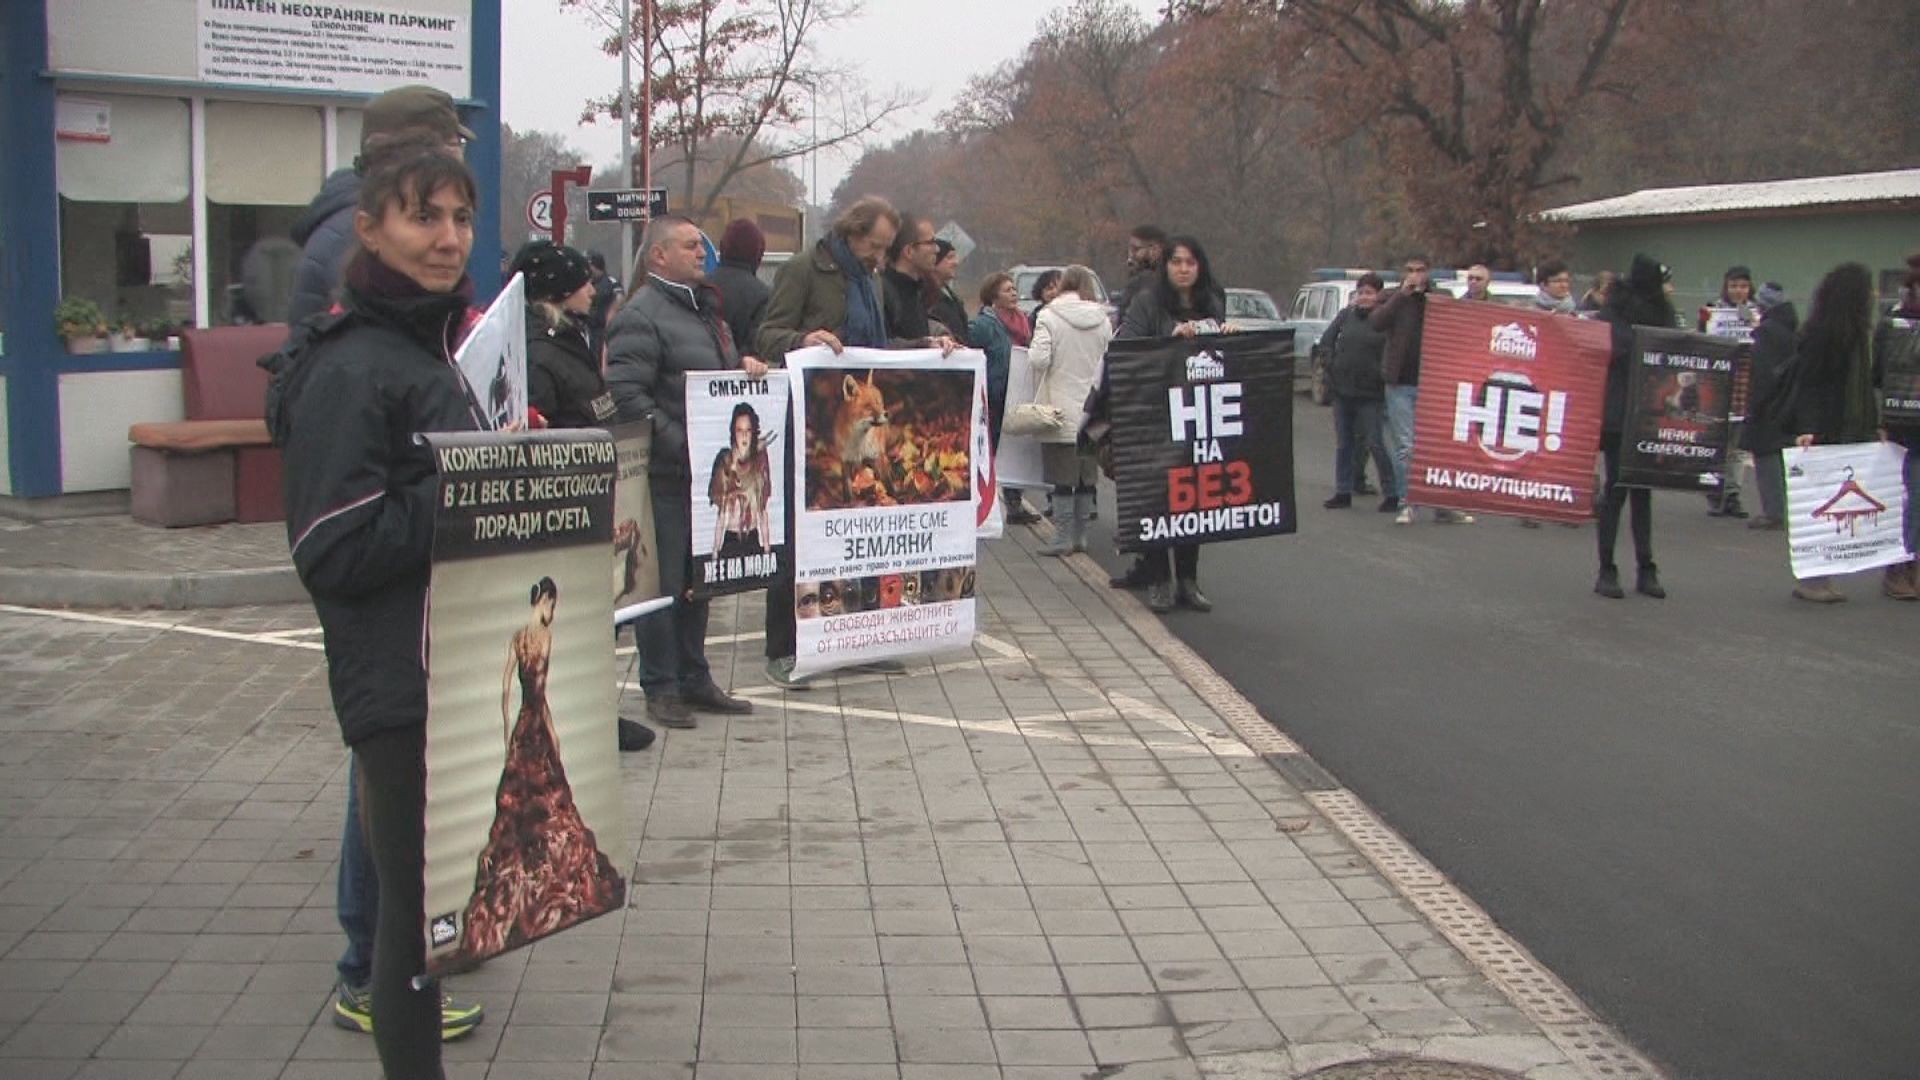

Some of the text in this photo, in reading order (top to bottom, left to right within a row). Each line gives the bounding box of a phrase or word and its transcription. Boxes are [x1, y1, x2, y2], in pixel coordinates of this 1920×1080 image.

[211, 0, 456, 32] ПЛАТЕН НЕОХРАНЯЕМ ПАРКИНГ
[708, 379, 769, 398] СМЪРТТА
[1167, 382, 1244, 442] НЕ
[1453, 381, 1567, 452] НЕ!
[440, 445, 528, 473] КОЖЕНАТА
[530, 442, 615, 469] ИНДУСТРИЯ
[1192, 438, 1224, 464] НА
[444, 484, 454, 507] В
[458, 482, 476, 507] 21
[481, 480, 510, 504] ВЕК
[515, 479, 525, 501] Е
[529, 473, 612, 500] ЖЕСТОКОСТ
[1167, 461, 1253, 514] БЕЗ
[1426, 468, 1573, 503] НА КОРУПЦИЯТА
[475, 506, 591, 541] ПОРАДИ СУЕТА
[825, 511, 949, 537] ВСИЧКИ НИЕ СМЕ
[1139, 502, 1280, 542] ЗАКОНИЕТО!
[844, 532, 933, 561] ЗЕМЛЯНИ
[727, 557, 743, 580] НА
[744, 552, 778, 578] МОДА
[824, 604, 953, 633] ОСВОБОДИ ЖИВОТНИТЕ
[818, 622, 959, 654] ОТ ПРЕДРАЗСЪДЪЦИТЕ СИ
